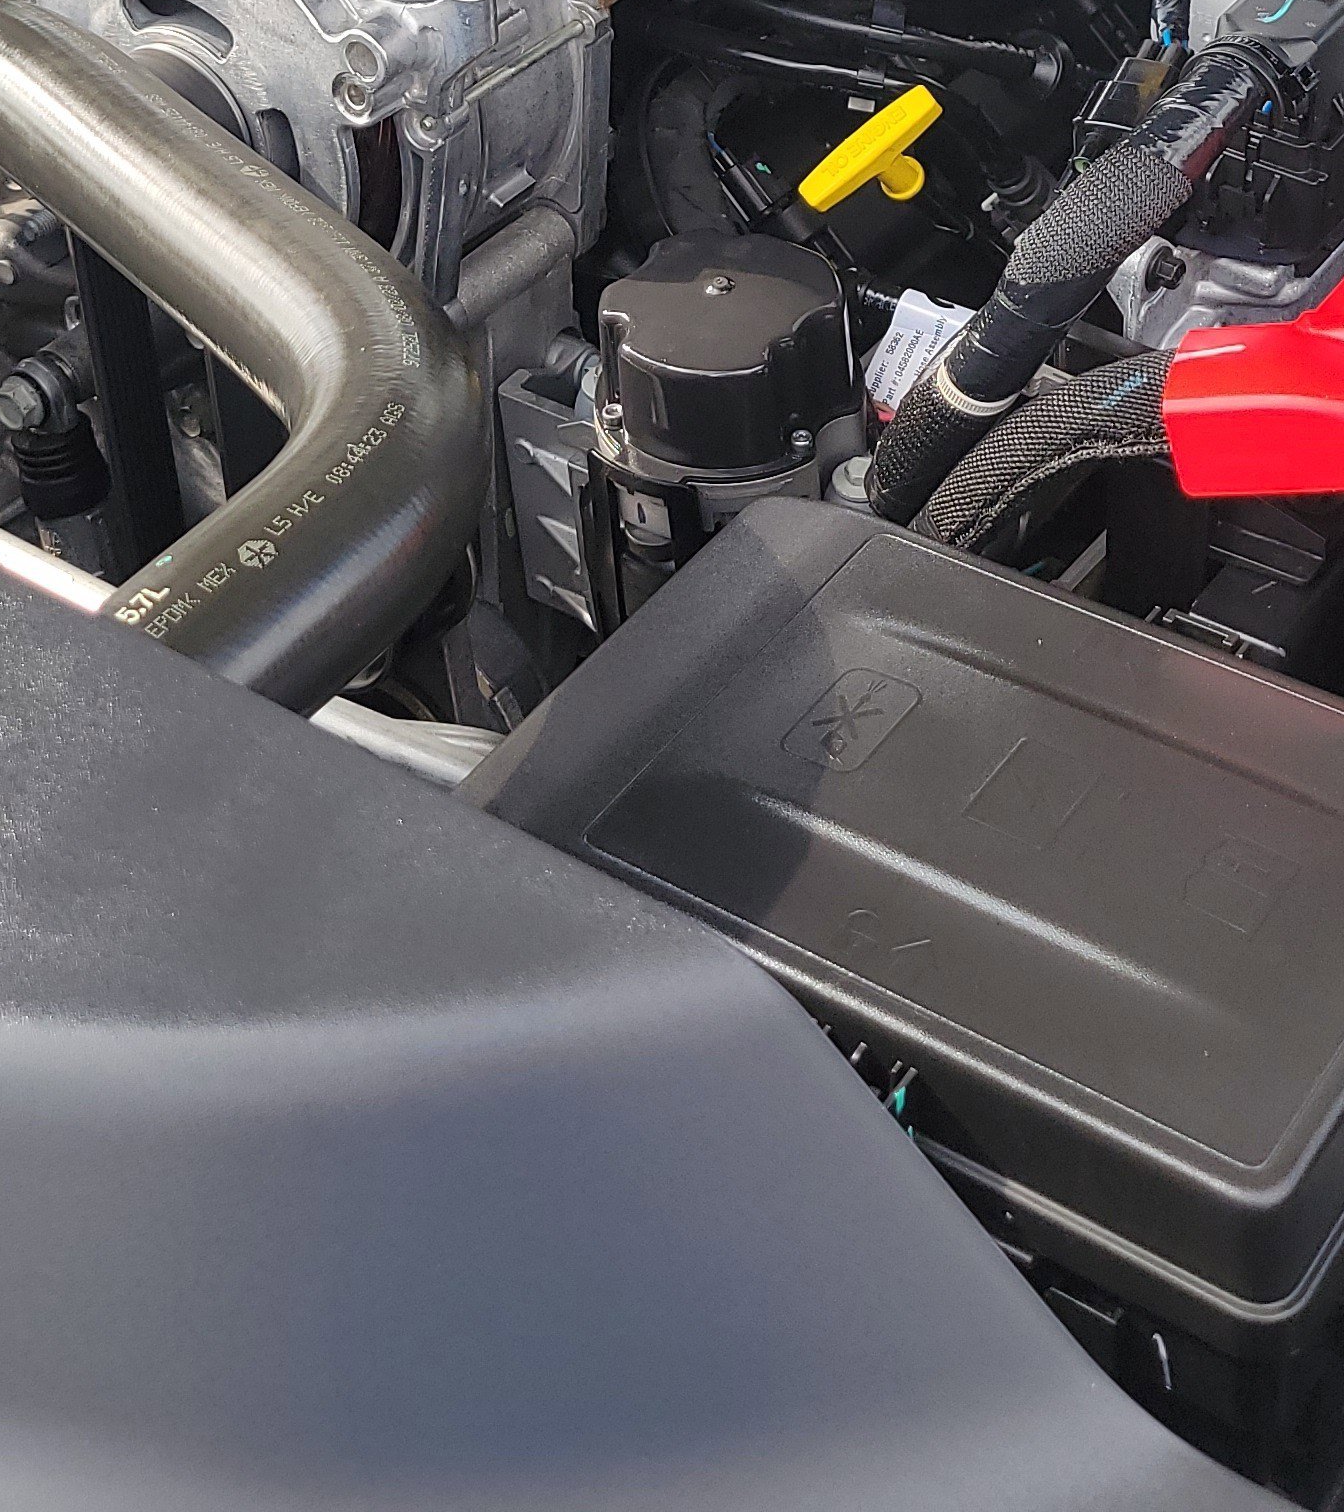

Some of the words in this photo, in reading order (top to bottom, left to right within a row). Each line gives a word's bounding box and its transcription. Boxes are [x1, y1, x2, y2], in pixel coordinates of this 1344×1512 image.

[882, 386, 897, 405] Part
[196, 561, 237, 593] MEX
[113, 587, 171, 626] 5.7L
